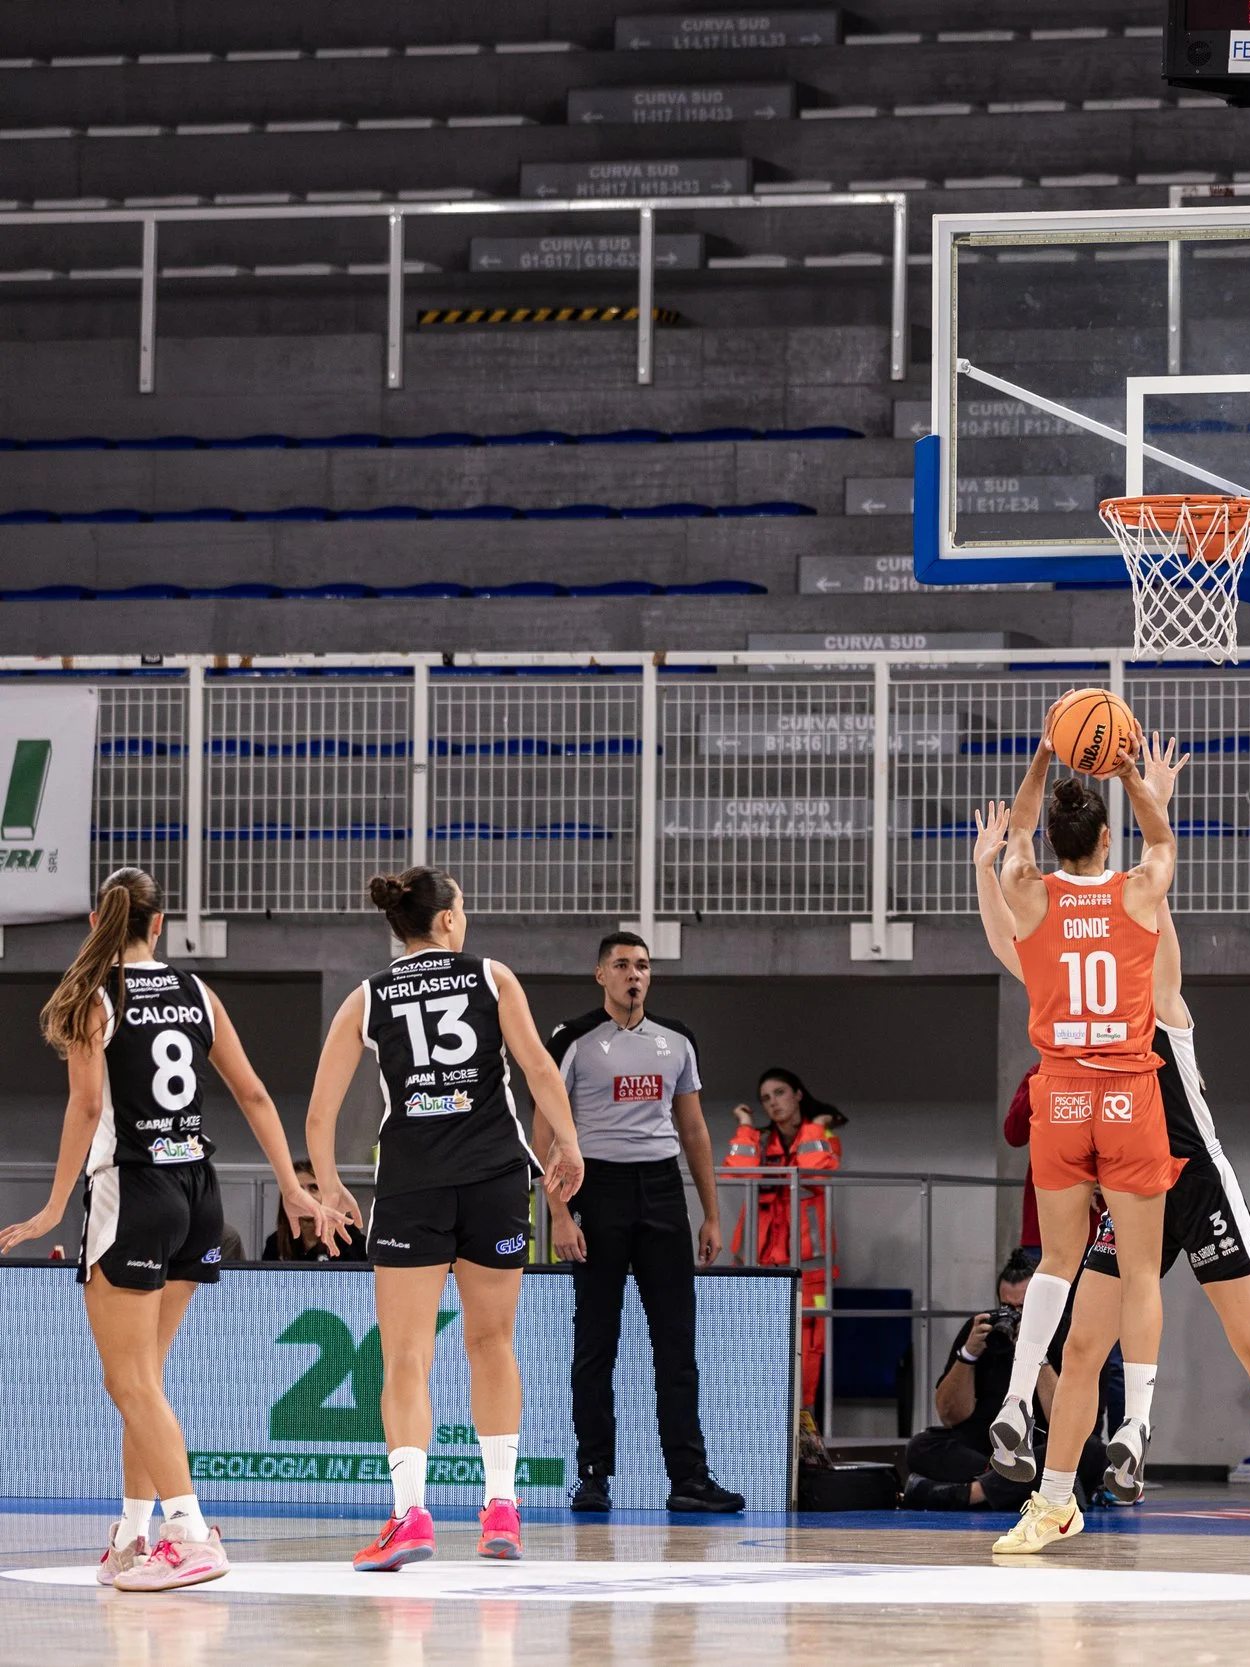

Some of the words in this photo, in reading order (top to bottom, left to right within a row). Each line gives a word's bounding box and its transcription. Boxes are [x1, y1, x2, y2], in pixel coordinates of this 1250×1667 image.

[681, 19, 735, 32] CURVA
[738, 17, 770, 31] SUD
[634, 92, 686, 105] CURVA
[691, 91, 723, 104] SUD
[589, 166, 642, 179] CURVA
[646, 165, 679, 177] SUD
[540, 239, 596, 252] CURVA
[600, 239, 631, 251] SUD
[584, 253, 639, 268] G18-G3
[968, 403, 1026, 416] CURVA
[984, 479, 1019, 493] SUD
[978, 499, 1039, 513] E17-E34
[876, 558, 914, 572] CUR
[825, 636, 885, 650] CURVA
[889, 635, 927, 649] SUD
[777, 716, 840, 730] CURVA
[1078, 724, 1106, 771] Wilson
[727, 802, 788, 816] CURVA
[795, 802, 830, 816] SUD
[1078, 898, 1112, 906] MASTER
[392, 958, 451, 974] DATAONE
[377, 973, 478, 1001] VERLASEVIC
[1059, 950, 1118, 1016] 10
[126, 1005, 203, 1026] CALORO
[391, 993, 478, 1067] 13
[152, 1029, 197, 1111] 8
[620, 1076, 659, 1088] ATTAL
[619, 1088, 659, 1097] GROUP
[1055, 1096, 1086, 1106] PISCINE
[1054, 1105, 1091, 1119] SCHIO
[1209, 1209, 1227, 1236] 3
[495, 1233, 525, 1255] GLS
[193, 1456, 320, 1480] ECOLOGIA
[326, 1458, 352, 1479] IN
